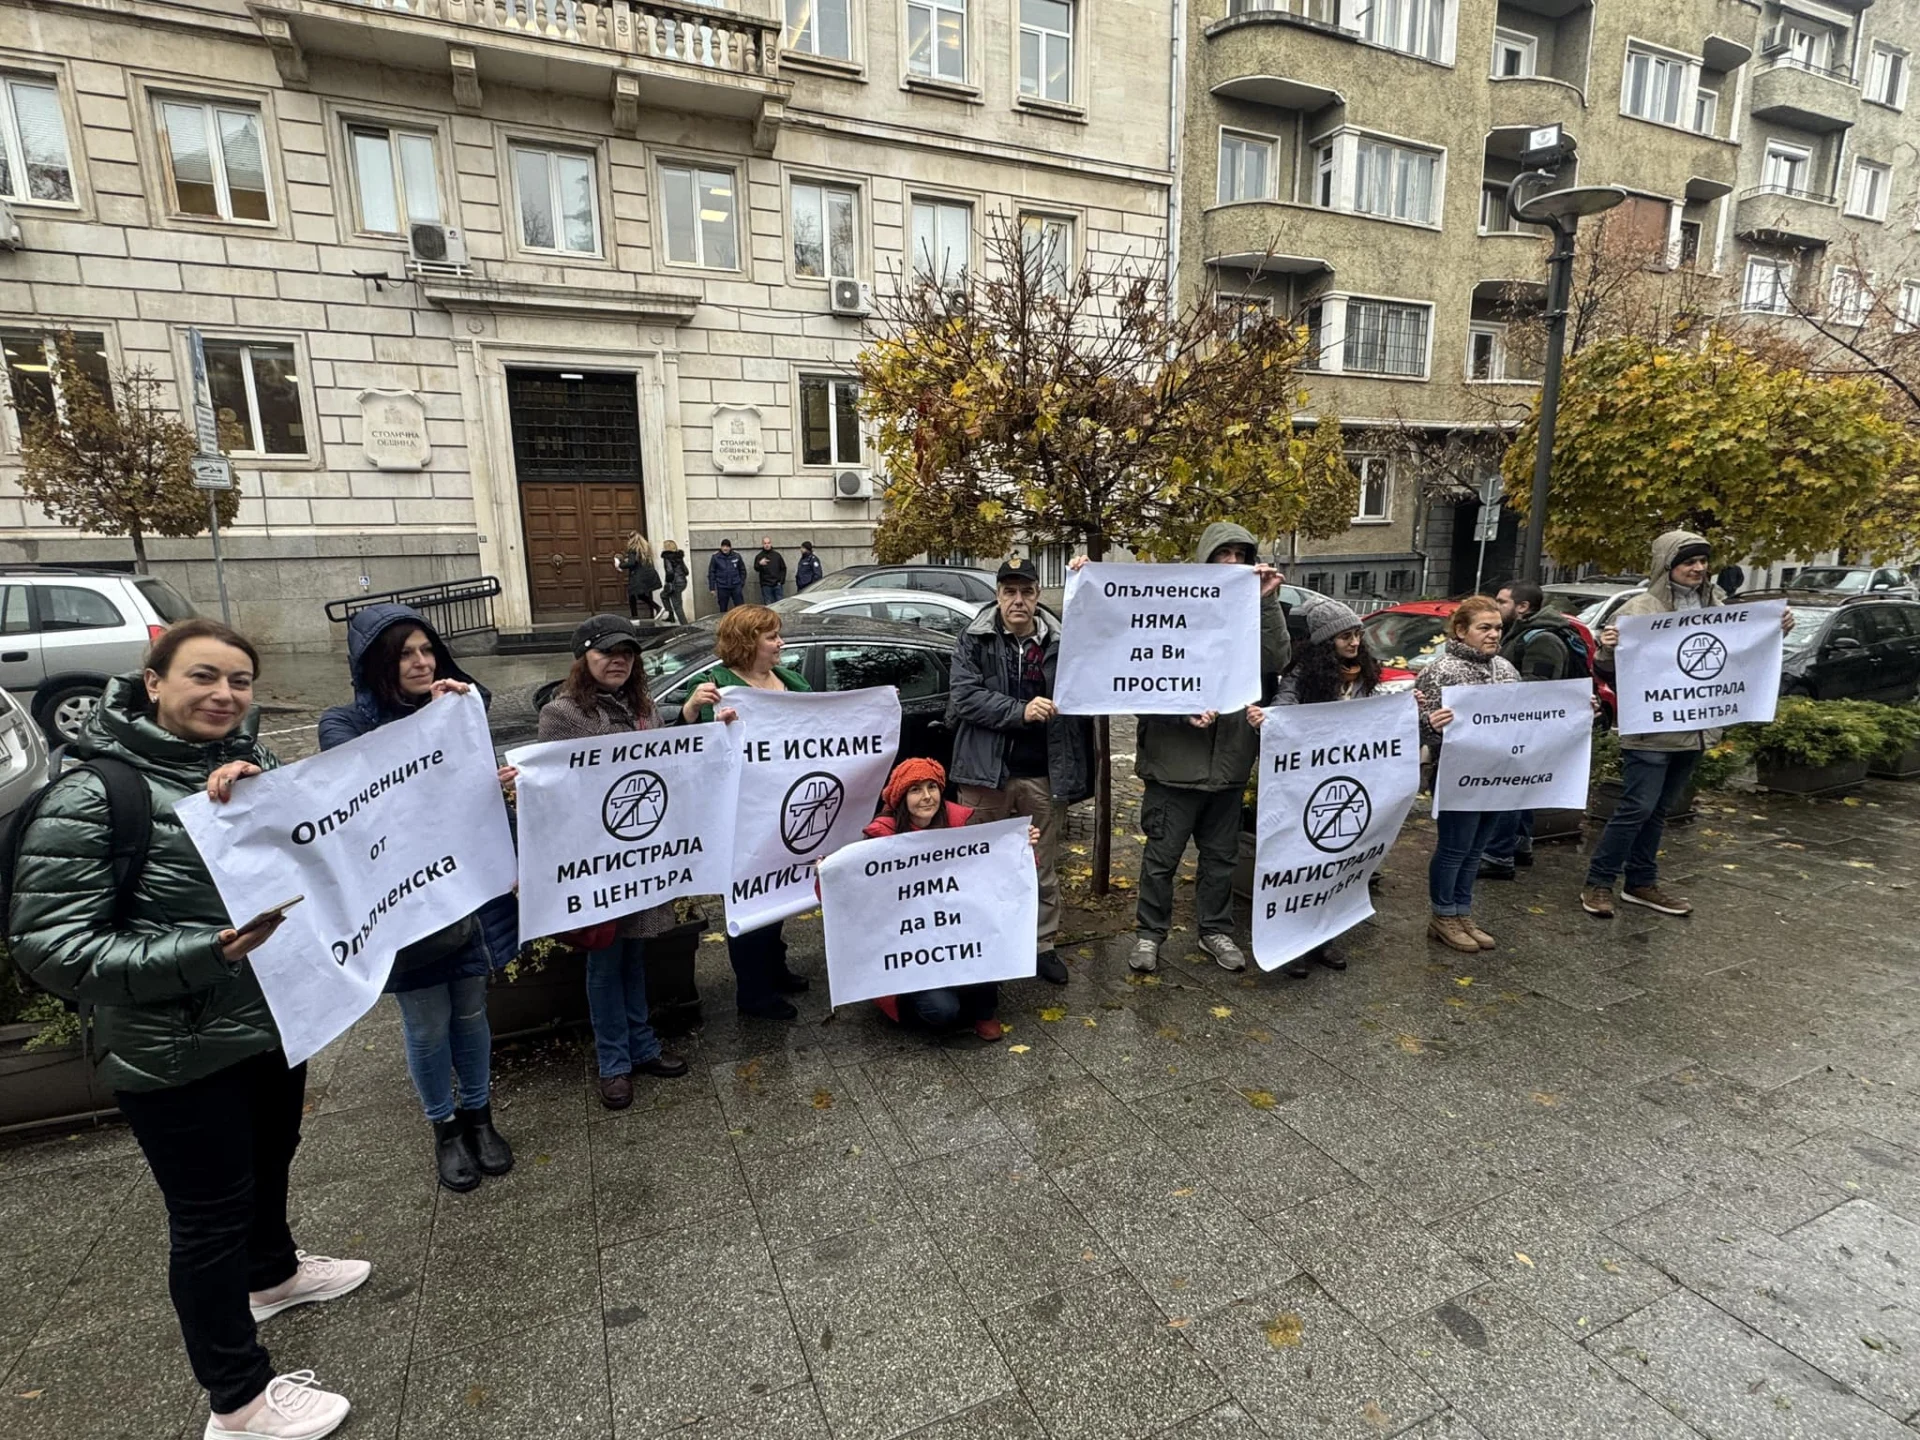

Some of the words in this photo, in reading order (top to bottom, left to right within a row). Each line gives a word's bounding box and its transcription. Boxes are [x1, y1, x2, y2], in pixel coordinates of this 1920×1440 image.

[1104, 582, 1220, 598] Опълченска
[1131, 614, 1187, 628] НЯМА
[1650, 618, 1674, 630] НЕ
[1678, 610, 1749, 628] ИСКАМЕ
[1130, 647, 1154, 661] да
[1162, 644, 1185, 659] Ви
[1113, 677, 1202, 692] ПРОСТИ!
[1644, 681, 1746, 702] МАГИСТРАЛА
[1472, 708, 1566, 724] Опълченците
[1653, 712, 1664, 722] В
[1673, 703, 1738, 724] ЦЕНТЪРА
[570, 749, 602, 768] НЕ
[612, 736, 704, 763] ИСКАМЕ
[743, 741, 771, 763] НЕ
[784, 735, 883, 760] ИСКАМЕ
[1274, 752, 1300, 774] НЕ
[1311, 738, 1402, 768] ИСКАМЕ
[1512, 744, 1526, 755] от
[1458, 772, 1553, 787] Опълченска
[290, 749, 444, 846] Опълченците
[370, 836, 388, 861] от
[557, 836, 704, 884] МАГИСТРАЛА
[864, 842, 990, 876] Опълченска
[1261, 842, 1386, 891] МАГИСТРАЛА
[567, 896, 582, 914] В
[593, 868, 693, 910] ЦЕНТЪРА
[898, 876, 960, 901] НЯМА
[1266, 902, 1277, 920] В
[1284, 868, 1364, 914] ЦЕНТЪРА
[330, 854, 458, 967] Опълченска
[900, 916, 925, 935] да
[934, 910, 961, 927] Ви
[884, 942, 982, 970] ПРОСТИ!
